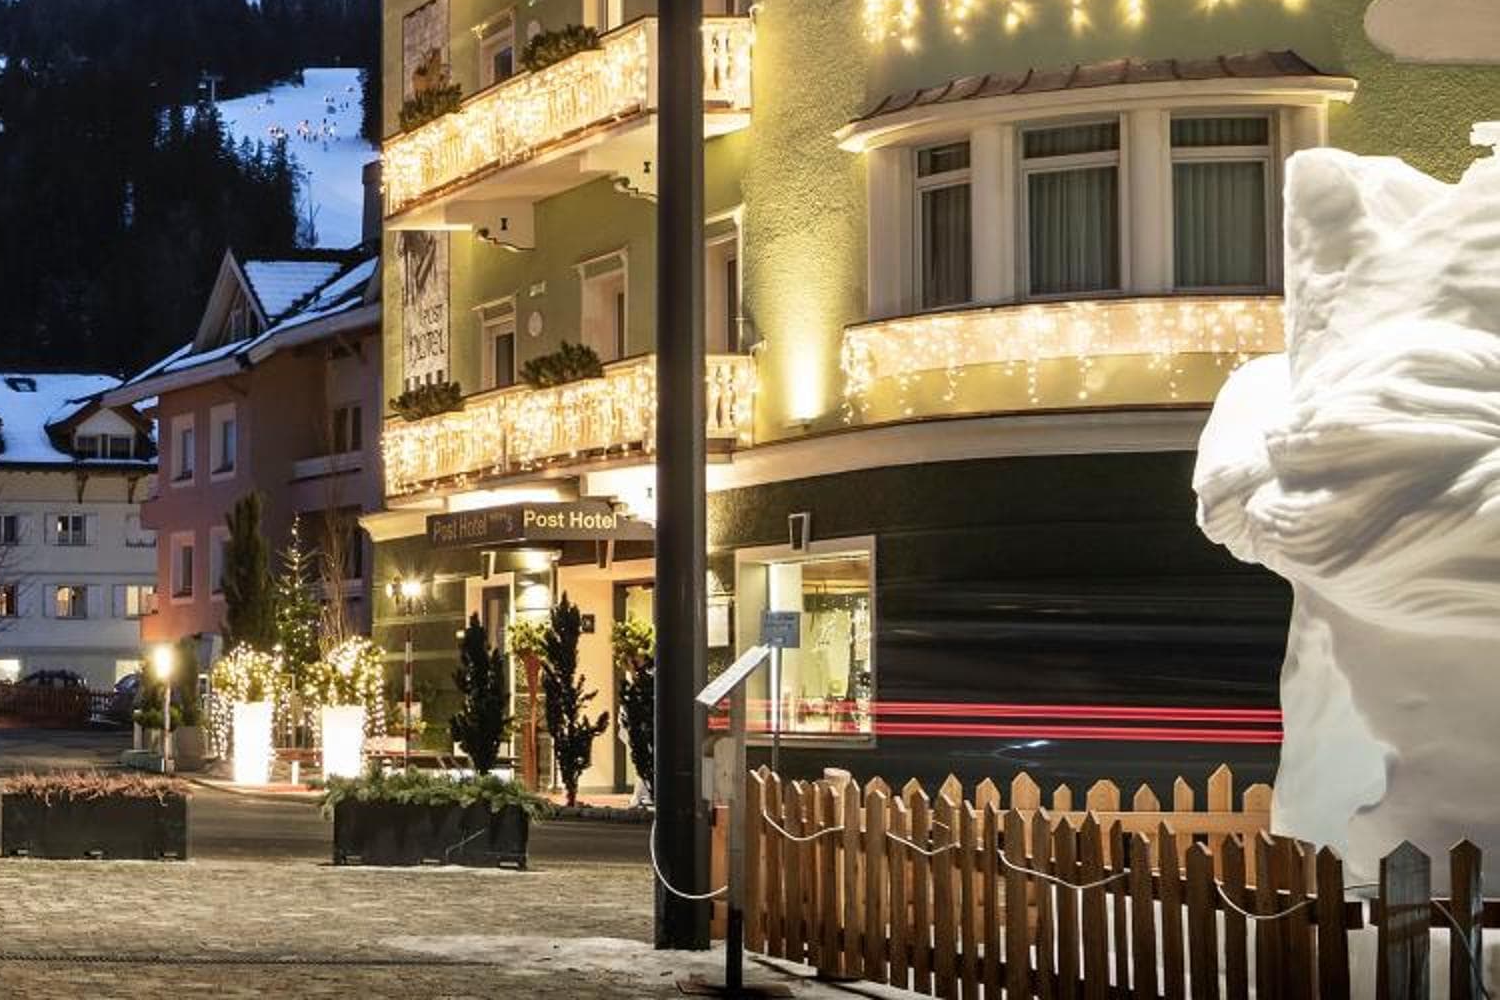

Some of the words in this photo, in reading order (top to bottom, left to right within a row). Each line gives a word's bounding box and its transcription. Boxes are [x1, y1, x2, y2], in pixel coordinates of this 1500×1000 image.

[433, 519, 457, 542] Post
[459, 511, 488, 538] Hotel
[523, 509, 565, 528] Post
[569, 511, 617, 529] Hotel
